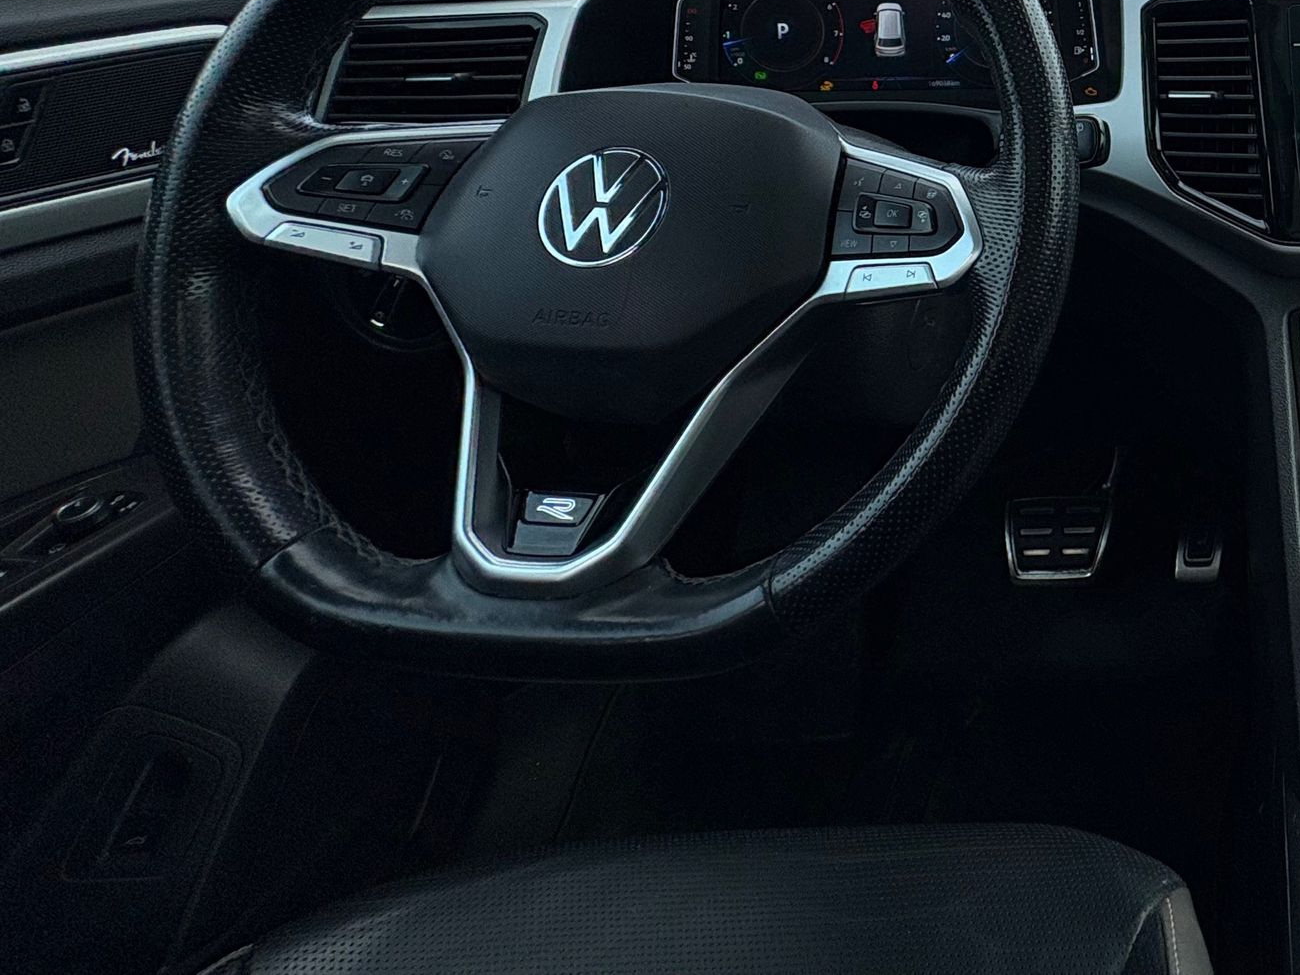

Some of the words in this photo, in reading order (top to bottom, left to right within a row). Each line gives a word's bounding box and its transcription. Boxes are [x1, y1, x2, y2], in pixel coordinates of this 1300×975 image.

[776, 22, 790, 40] P
[383, 148, 404, 157] RES
[335, 203, 358, 214] SET
[886, 210, 900, 218] OK
[532, 308, 612, 327] AIRBAG
